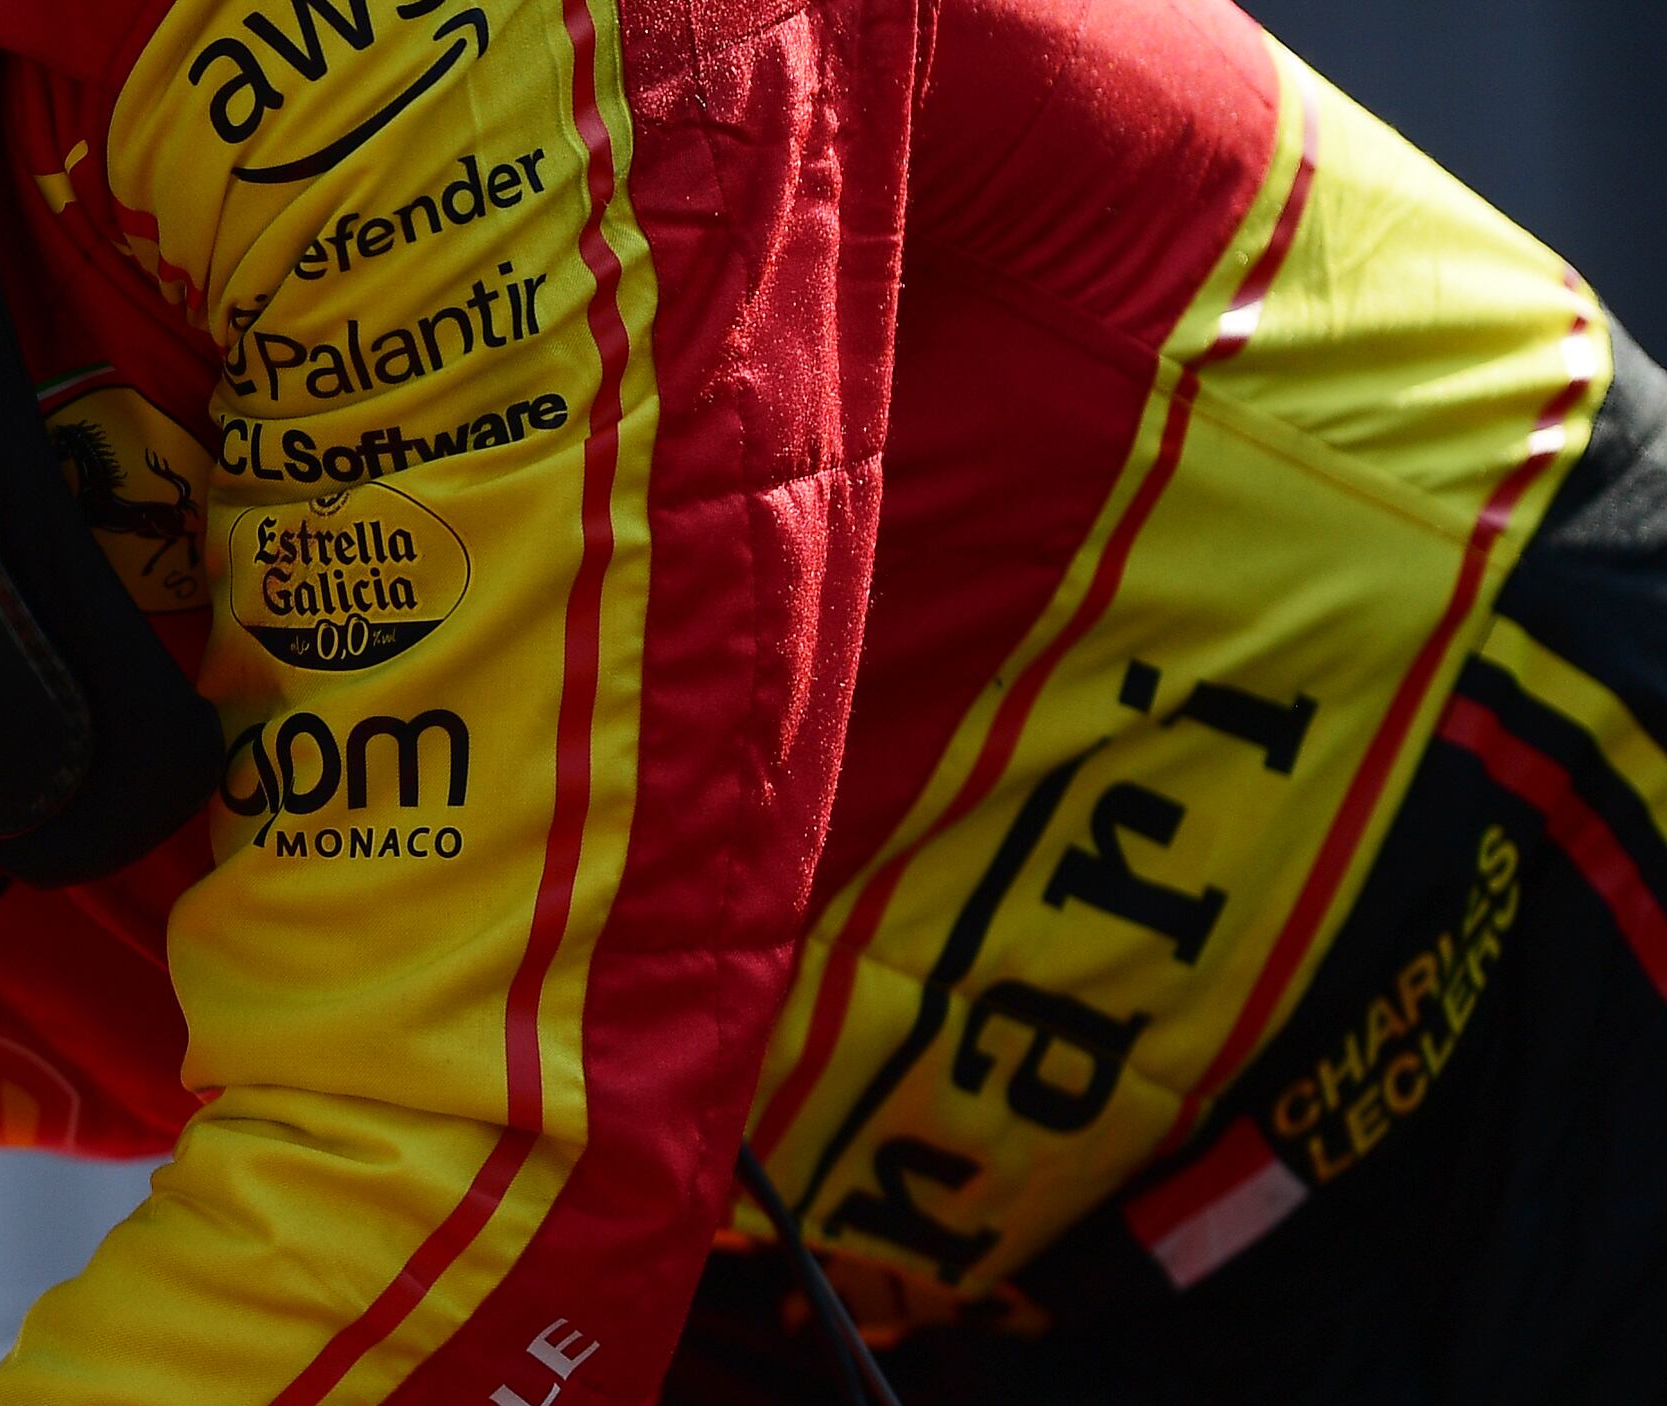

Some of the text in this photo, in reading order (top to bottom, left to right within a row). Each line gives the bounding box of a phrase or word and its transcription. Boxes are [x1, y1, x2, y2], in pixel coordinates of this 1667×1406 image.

[253, 261, 547, 402] Palantir
[218, 391, 569, 484] CLSoftware
[254, 515, 419, 567] Estrella
[261, 566, 420, 617] Galicia
[316, 613, 370, 661] 0,0
[219, 708, 471, 849] apm
[275, 826, 464, 860] MONACO
